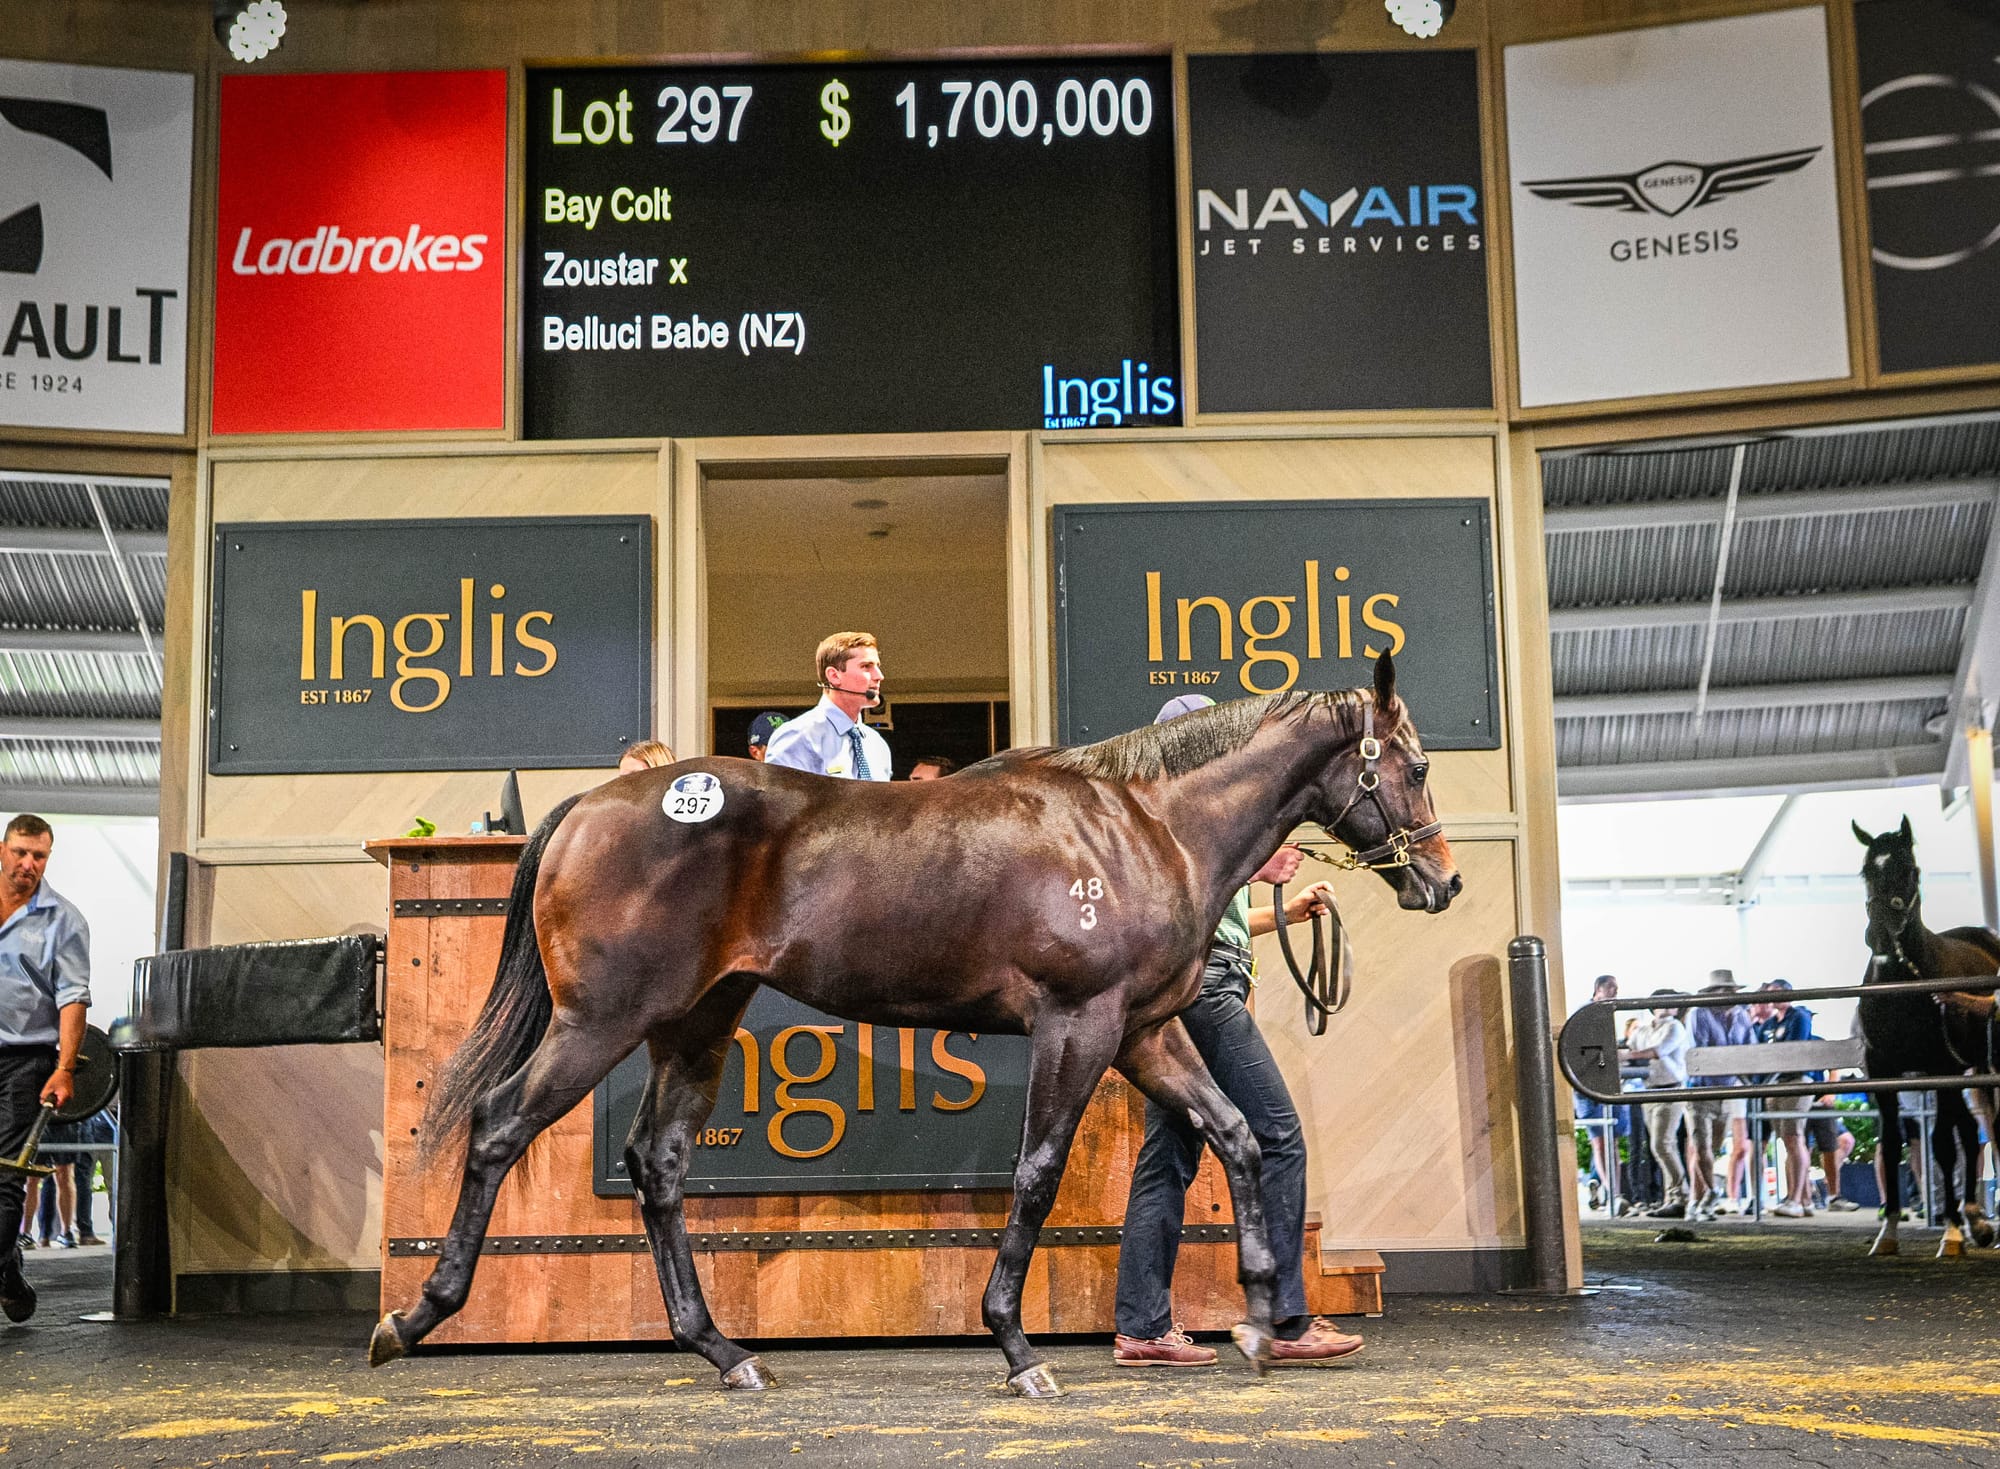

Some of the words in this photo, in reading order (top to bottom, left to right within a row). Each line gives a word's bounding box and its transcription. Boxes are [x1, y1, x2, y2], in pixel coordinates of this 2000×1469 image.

[552, 89, 632, 144] Lot
[657, 86, 752, 142] 297
[820, 80, 850, 146] $
[896, 78, 1152, 148] 1,700,000
[1644, 175, 1696, 188] GENESIS
[545, 189, 602, 229] Bay
[611, 187, 671, 221] Colt
[232, 223, 488, 276] Ladbrokes
[1200, 239, 1261, 255] JET
[1293, 234, 1481, 253] SERVICES
[1610, 227, 1738, 262] GENESIS
[543, 252, 658, 287] Zoustar
[669, 258, 687, 284] x
[544, 316, 641, 351] Belluci
[651, 315, 729, 349] Babe
[739, 313, 805, 356] (NZ)
[0, 372, 16, 390] E
[31, 374, 82, 392] 1924
[1043, 358, 1175, 427] Inglis
[1044, 417, 1059, 429] Est
[1061, 417, 1087, 428] 1867
[1146, 560, 1406, 694] Inglis
[300, 578, 558, 713] Inglis
[1149, 671, 1177, 685] EST
[1182, 671, 1221, 684] 1867
[300, 690, 327, 705] EST
[333, 689, 372, 703] 1867
[673, 797, 710, 814] 297
[1069, 877, 1104, 900] 48
[1080, 903, 1098, 930] 3
[733, 1022, 986, 1158] nglis
